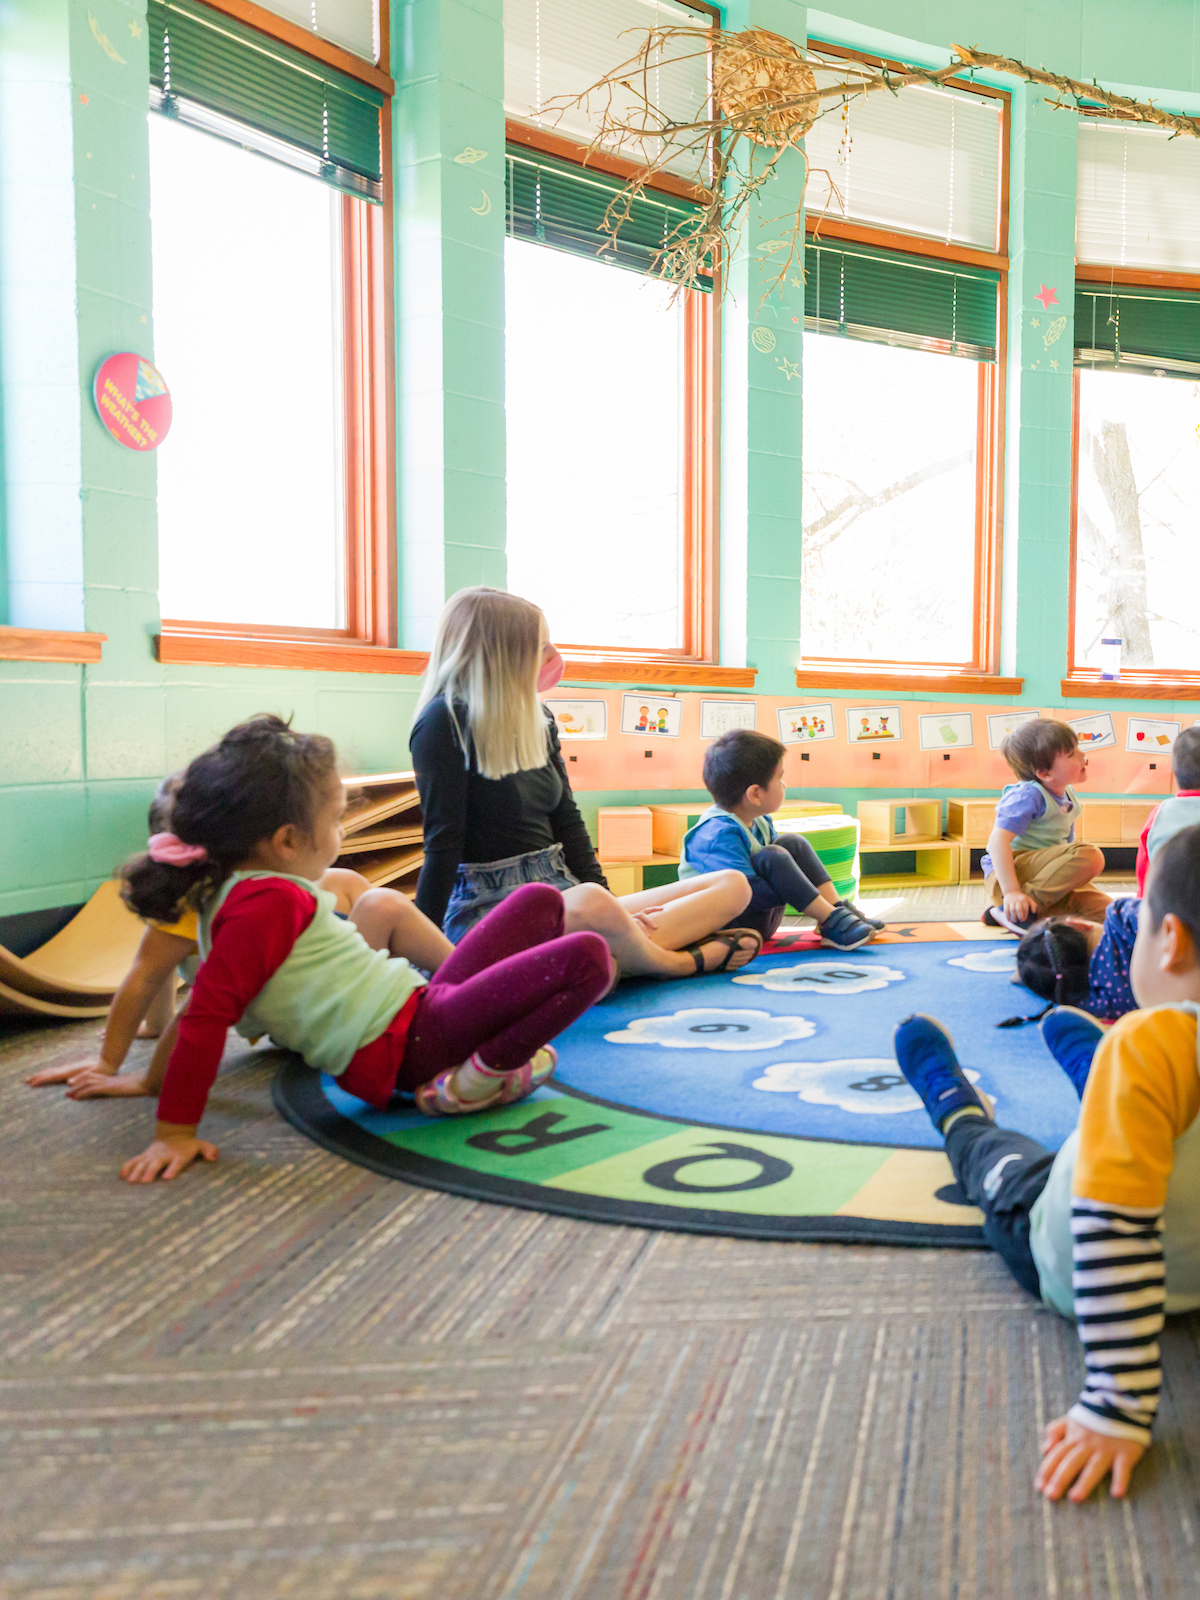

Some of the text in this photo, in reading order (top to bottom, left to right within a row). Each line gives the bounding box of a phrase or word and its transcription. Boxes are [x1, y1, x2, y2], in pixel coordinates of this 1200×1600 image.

[101, 393, 147, 447] WEATHER?
[104, 377, 140, 422] WHAT'S
[140, 418, 158, 442] THE
[792, 970, 869, 984] 10
[848, 1074, 905, 1093] 8
[465, 1110, 612, 1156] R
[643, 1142, 794, 1193] Q
